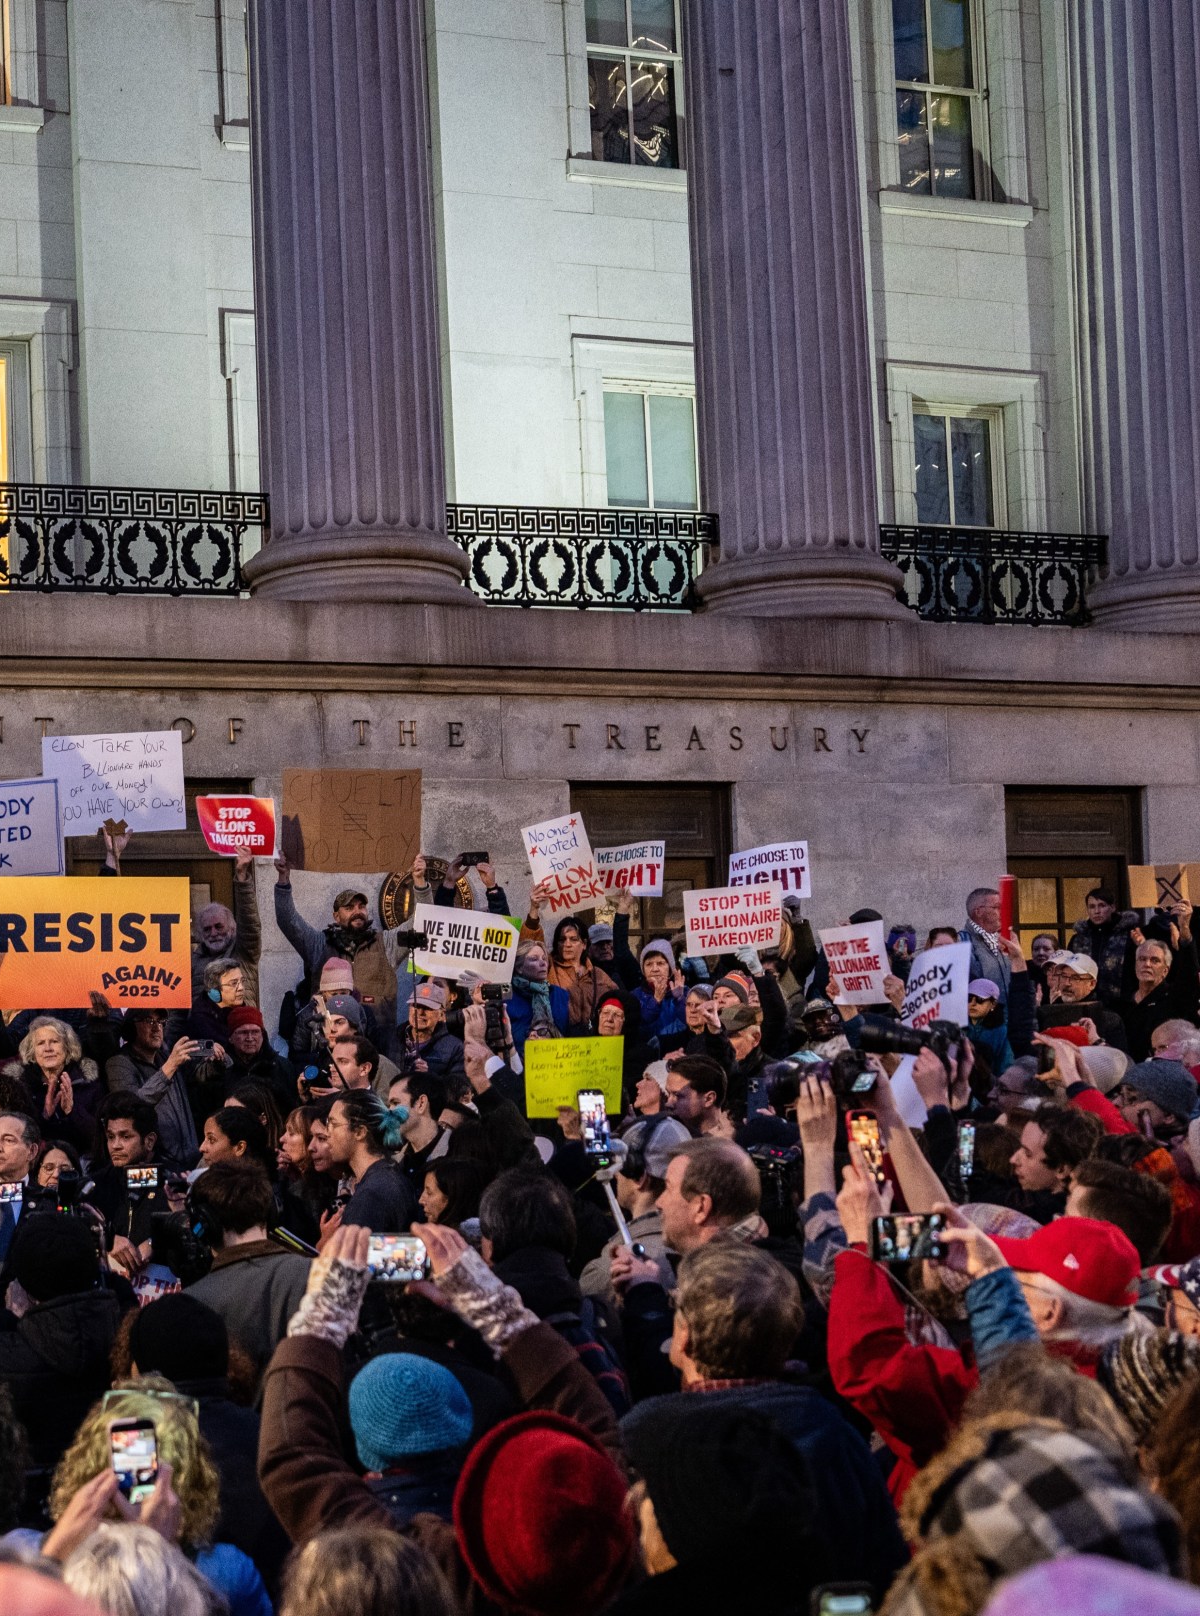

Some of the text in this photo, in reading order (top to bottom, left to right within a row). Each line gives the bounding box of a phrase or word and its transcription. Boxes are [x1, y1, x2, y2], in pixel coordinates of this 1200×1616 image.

[52, 739, 85, 753] ELON
[140, 735, 167, 754] YOUR
[170, 717, 245, 744] OF
[352, 719, 465, 748] THE
[562, 723, 871, 753] TREASURY
[138, 760, 163, 770] HANDS
[91, 782, 113, 792] OUR
[289, 773, 421, 810] CRUELTY
[87, 798, 115, 818] HAVE
[118, 798, 148, 816] YOUR
[218, 807, 252, 819] STOP
[215, 820, 256, 832] ELON'S
[209, 832, 265, 846] TAKEOVER
[528, 831, 545, 843] No
[538, 832, 579, 856] voted
[549, 857, 571, 872] for
[597, 845, 663, 864] WE CHOOSE TO
[731, 847, 804, 871] WE CHOOSE TO
[542, 860, 593, 895] ELON
[550, 879, 605, 912] MUSK
[699, 891, 771, 912] STOP THE
[690, 908, 780, 931] BILLIONAIRE
[423, 919, 511, 946] WE WILL NOT
[698, 927, 774, 948] TAKEOVER
[441, 939, 508, 963] SILENCED
[824, 937, 870, 957] STOP THE
[101, 965, 182, 991] AGAIN!
[842, 975, 873, 992] GRIFT!
[905, 963, 953, 997] obody
[119, 985, 160, 997] 2025
[900, 980, 952, 1021] Elected
[555, 1049, 592, 1060] LOOTER
